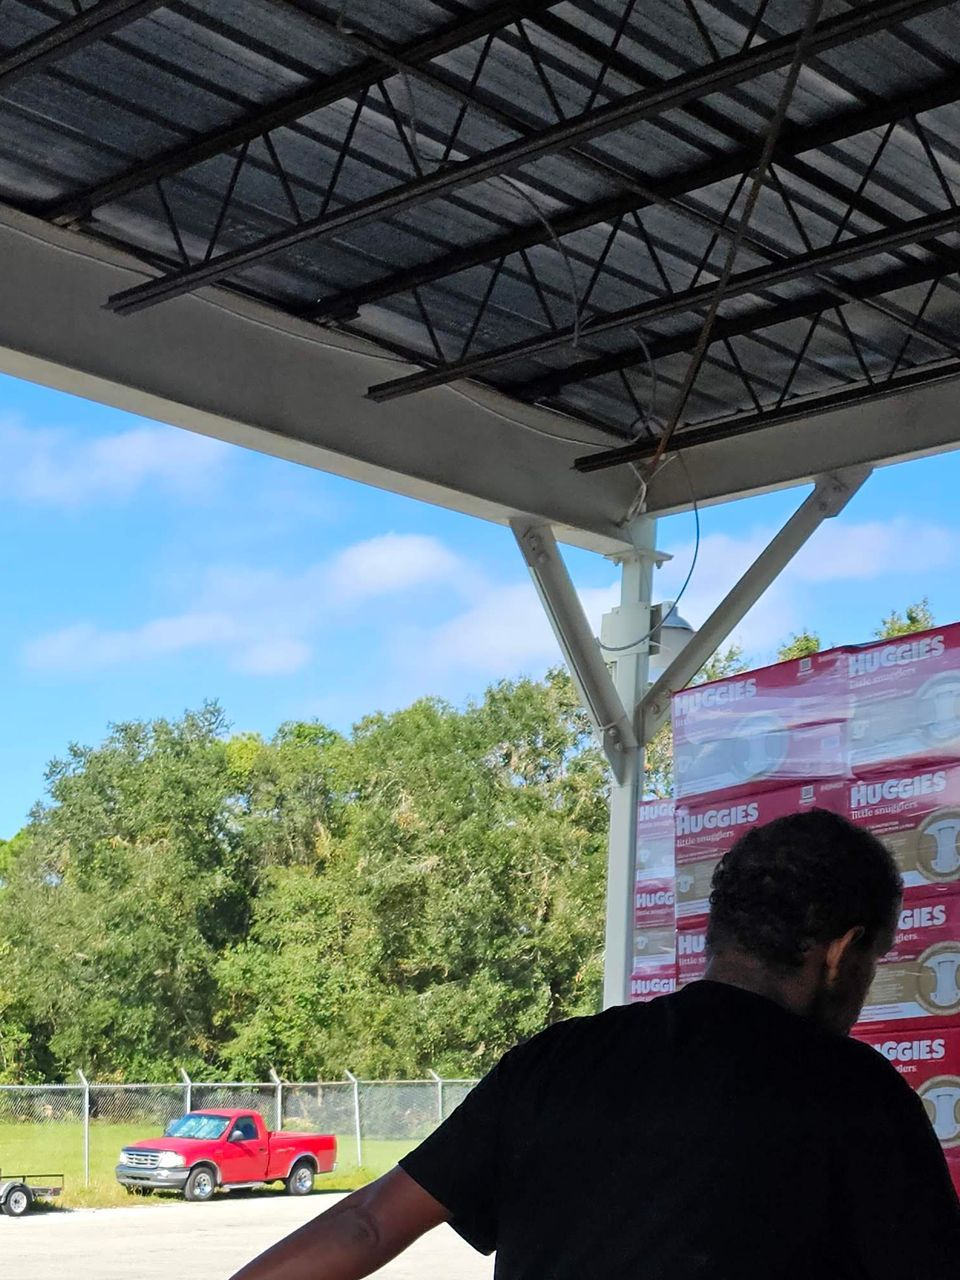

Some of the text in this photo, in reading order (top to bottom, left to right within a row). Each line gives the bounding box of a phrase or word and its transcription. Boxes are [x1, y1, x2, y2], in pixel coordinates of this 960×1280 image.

[848, 635, 945, 677] HUGGIES
[674, 678, 758, 717] HUGGIES
[850, 771, 947, 808] HUGGIES
[640, 803, 675, 821] HUGG
[677, 803, 758, 836] HUGGIES
[851, 801, 918, 820] little snugglers
[636, 891, 674, 909] HUGG
[898, 905, 946, 930] GIES
[632, 978, 674, 994] HUGGI
[878, 1039, 946, 1061] GGIES
